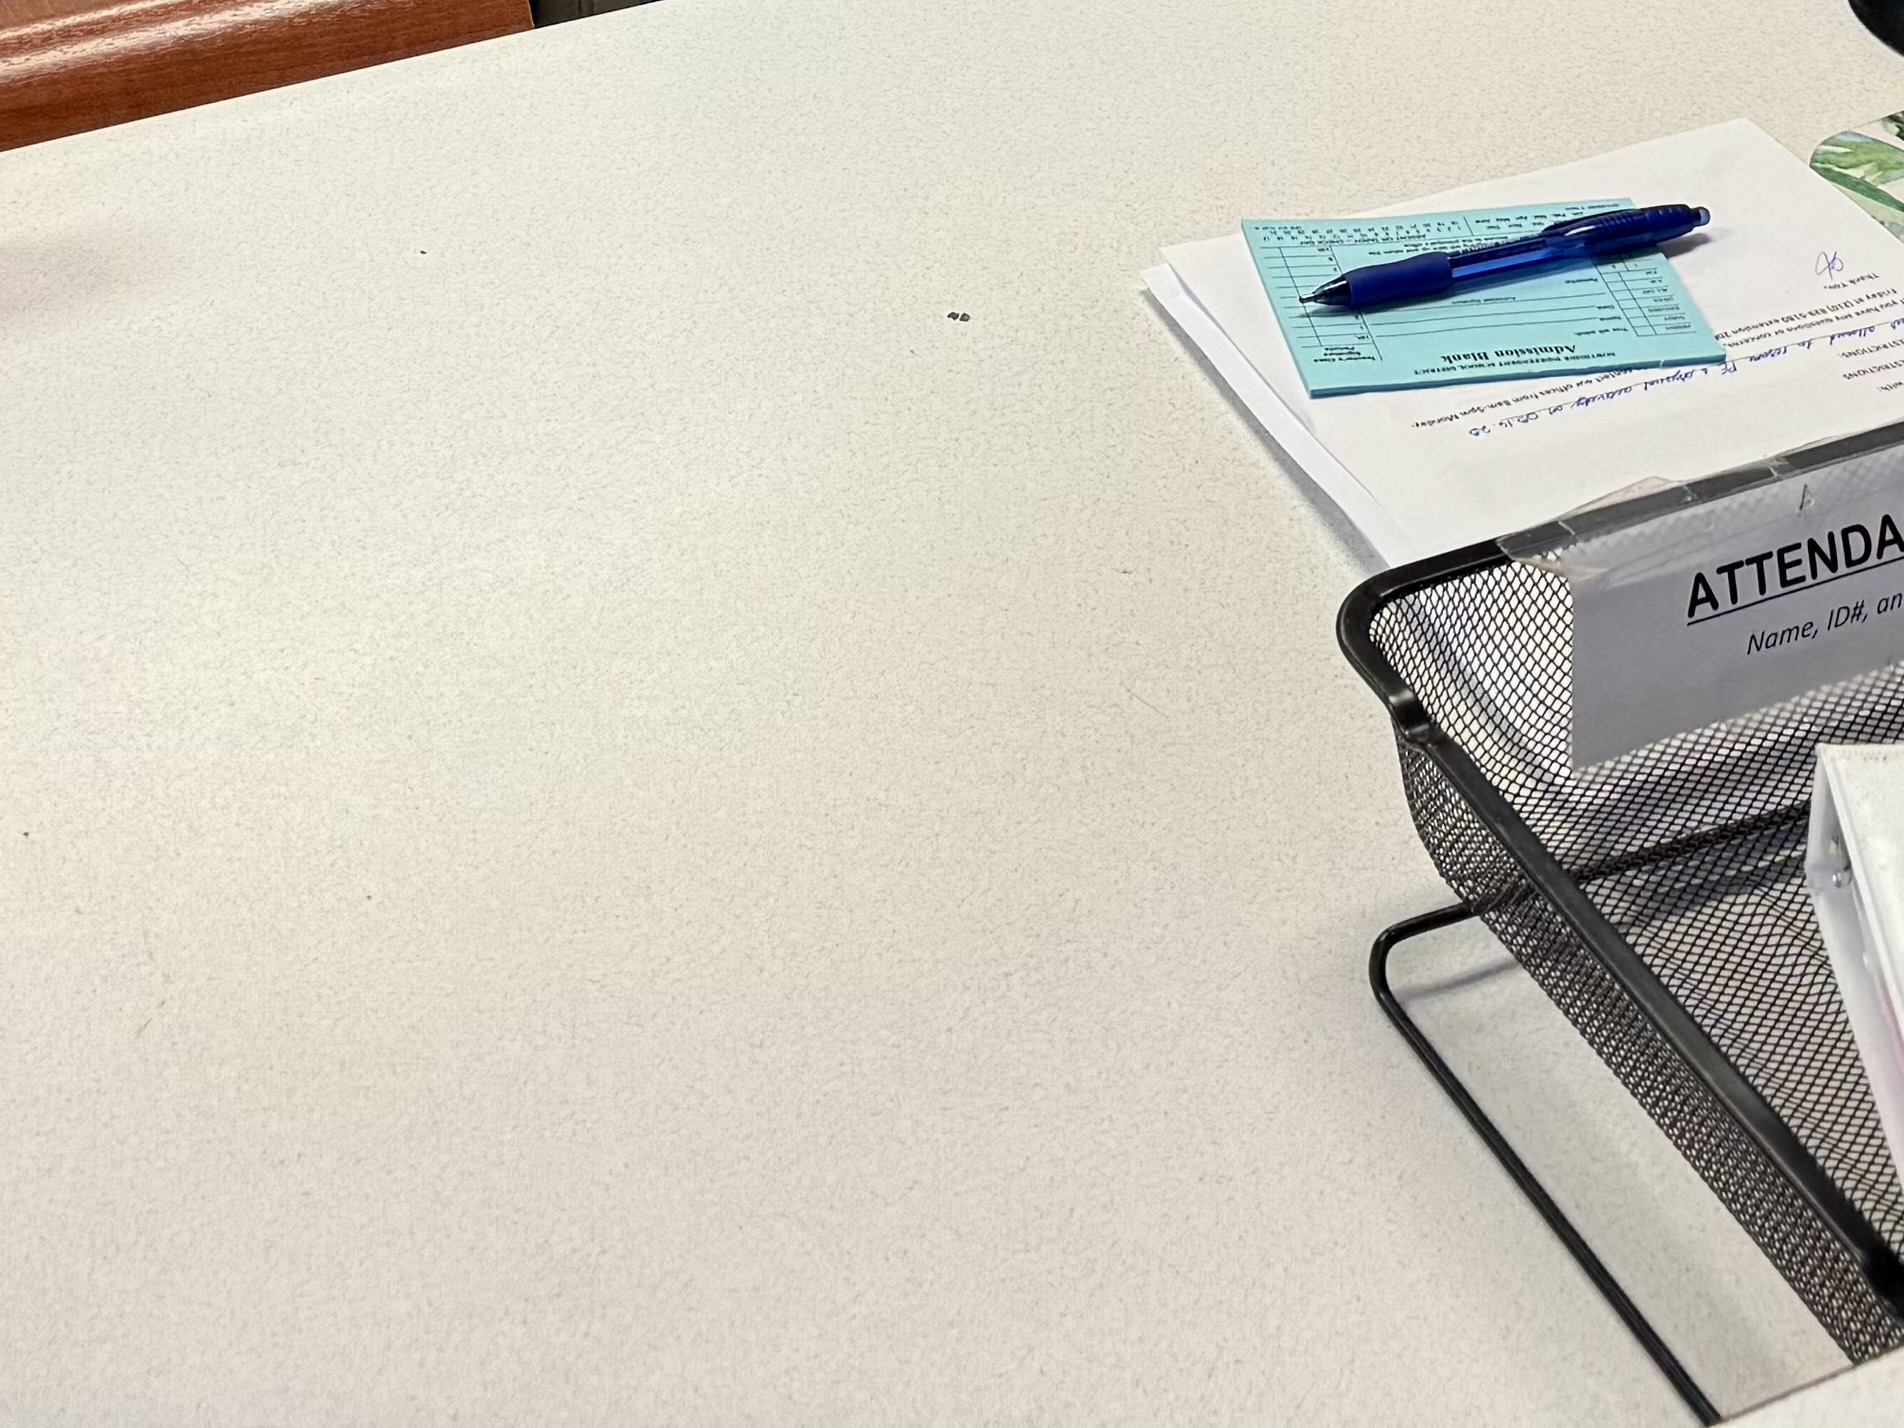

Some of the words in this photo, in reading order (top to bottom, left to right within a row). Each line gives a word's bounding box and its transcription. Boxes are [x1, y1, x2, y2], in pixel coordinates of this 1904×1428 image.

[1440, 349, 1491, 365] Blank
[1494, 343, 1577, 361] Admission
[1747, 619, 1819, 656] Name,
[1826, 600, 1869, 633] ID#,
